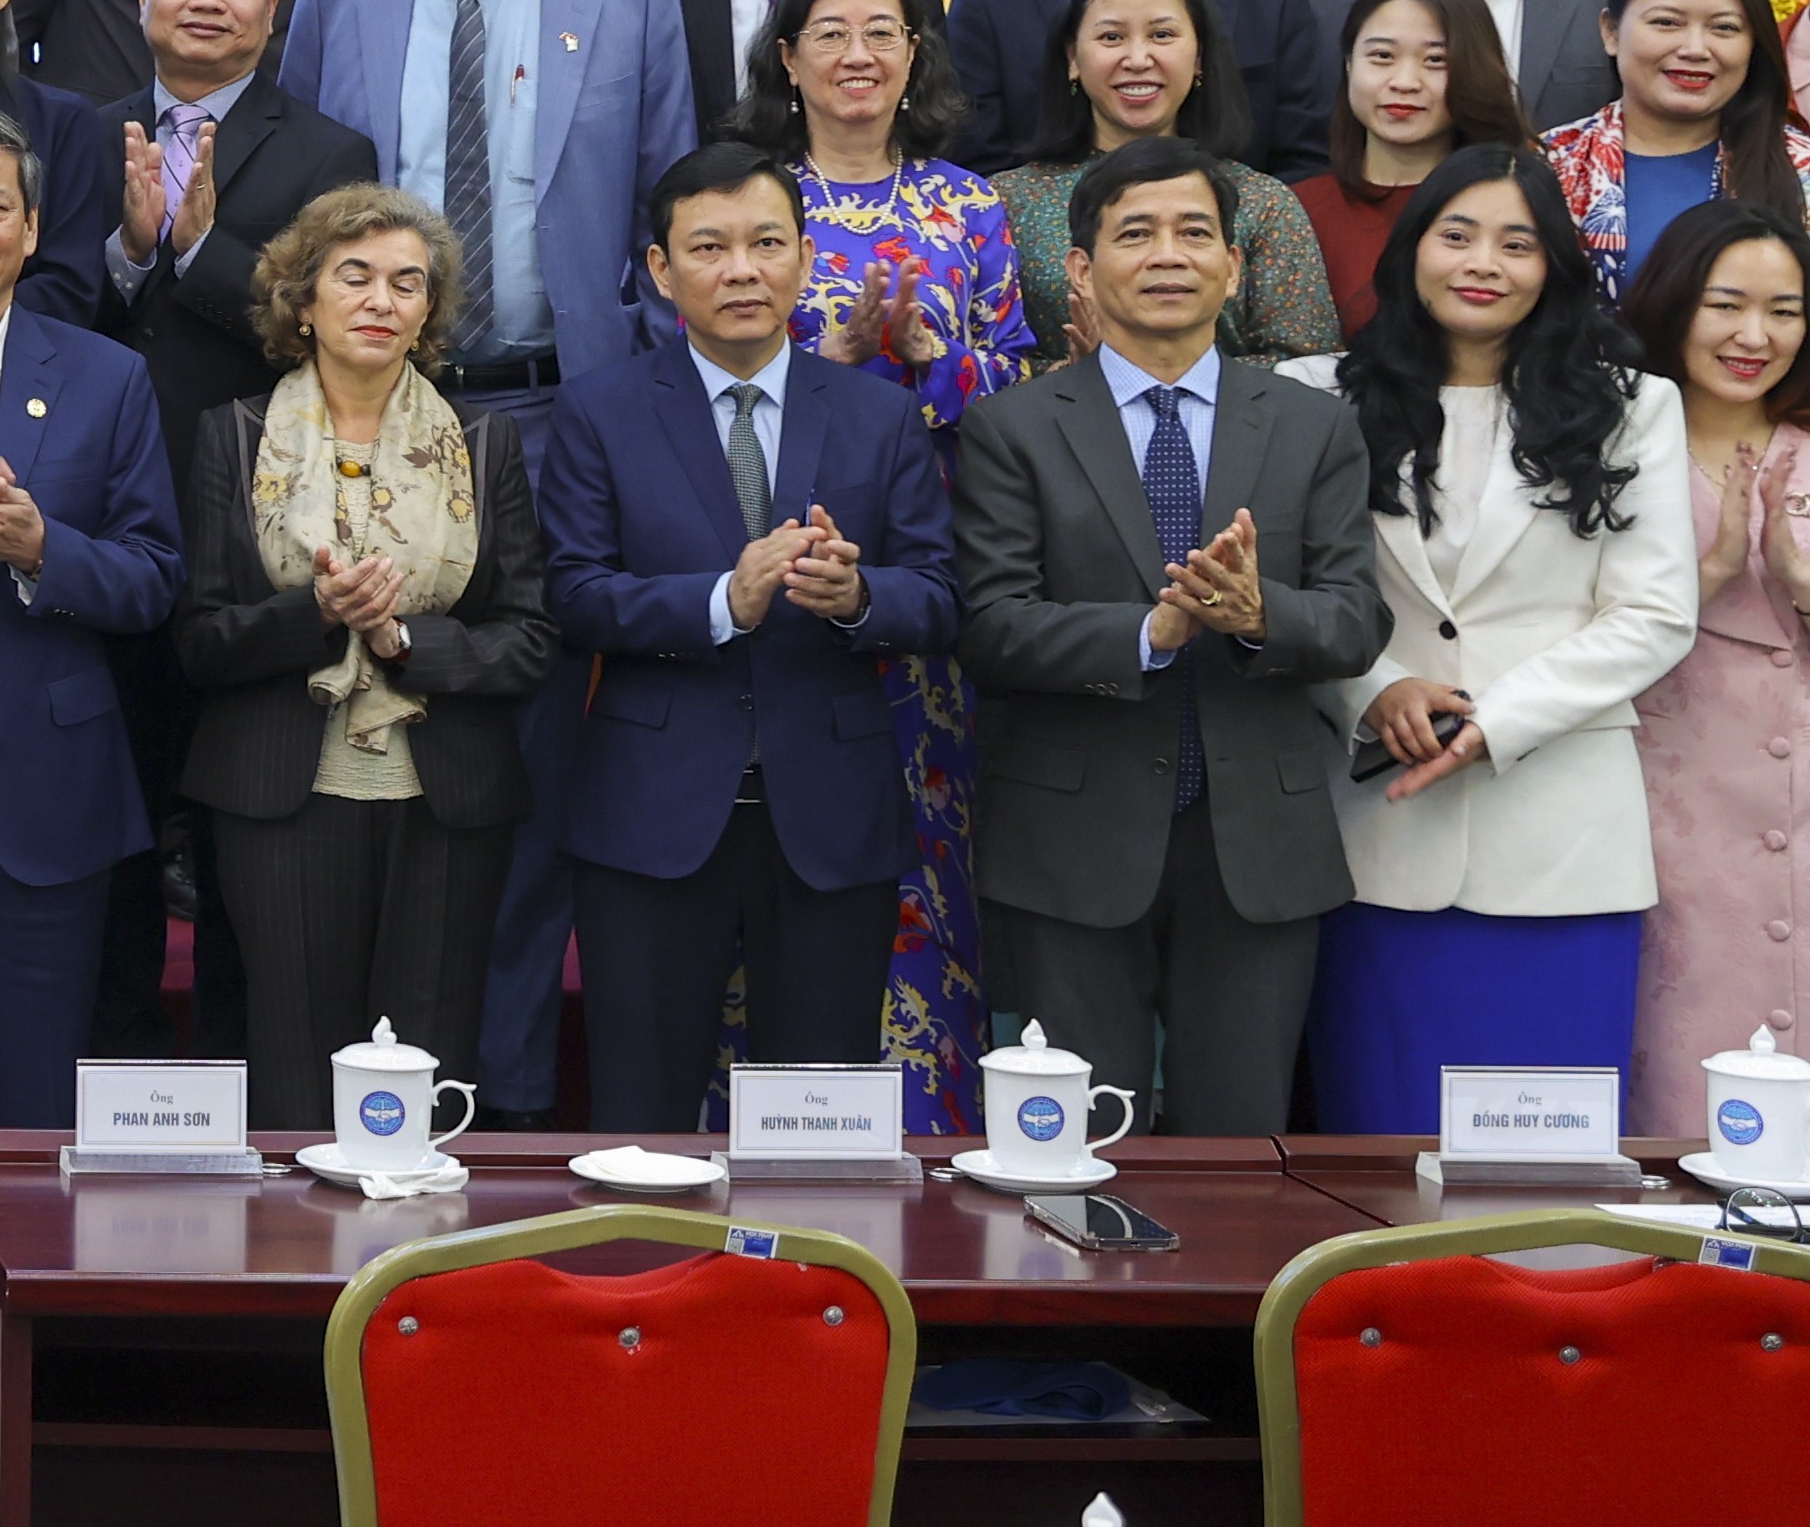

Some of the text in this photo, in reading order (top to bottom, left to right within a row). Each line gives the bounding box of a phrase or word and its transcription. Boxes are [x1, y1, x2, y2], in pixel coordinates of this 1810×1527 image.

[150, 1089, 174, 1105] Ông
[805, 1091, 828, 1106] Ông
[1518, 1091, 1542, 1105] Ông
[113, 1111, 211, 1127] PHAN ANH SƠN
[761, 1114, 872, 1131] HUỲNH THANH XUÂN
[1513, 1113, 1540, 1128] HUY
[1543, 1113, 1590, 1129] CƯƠNG
